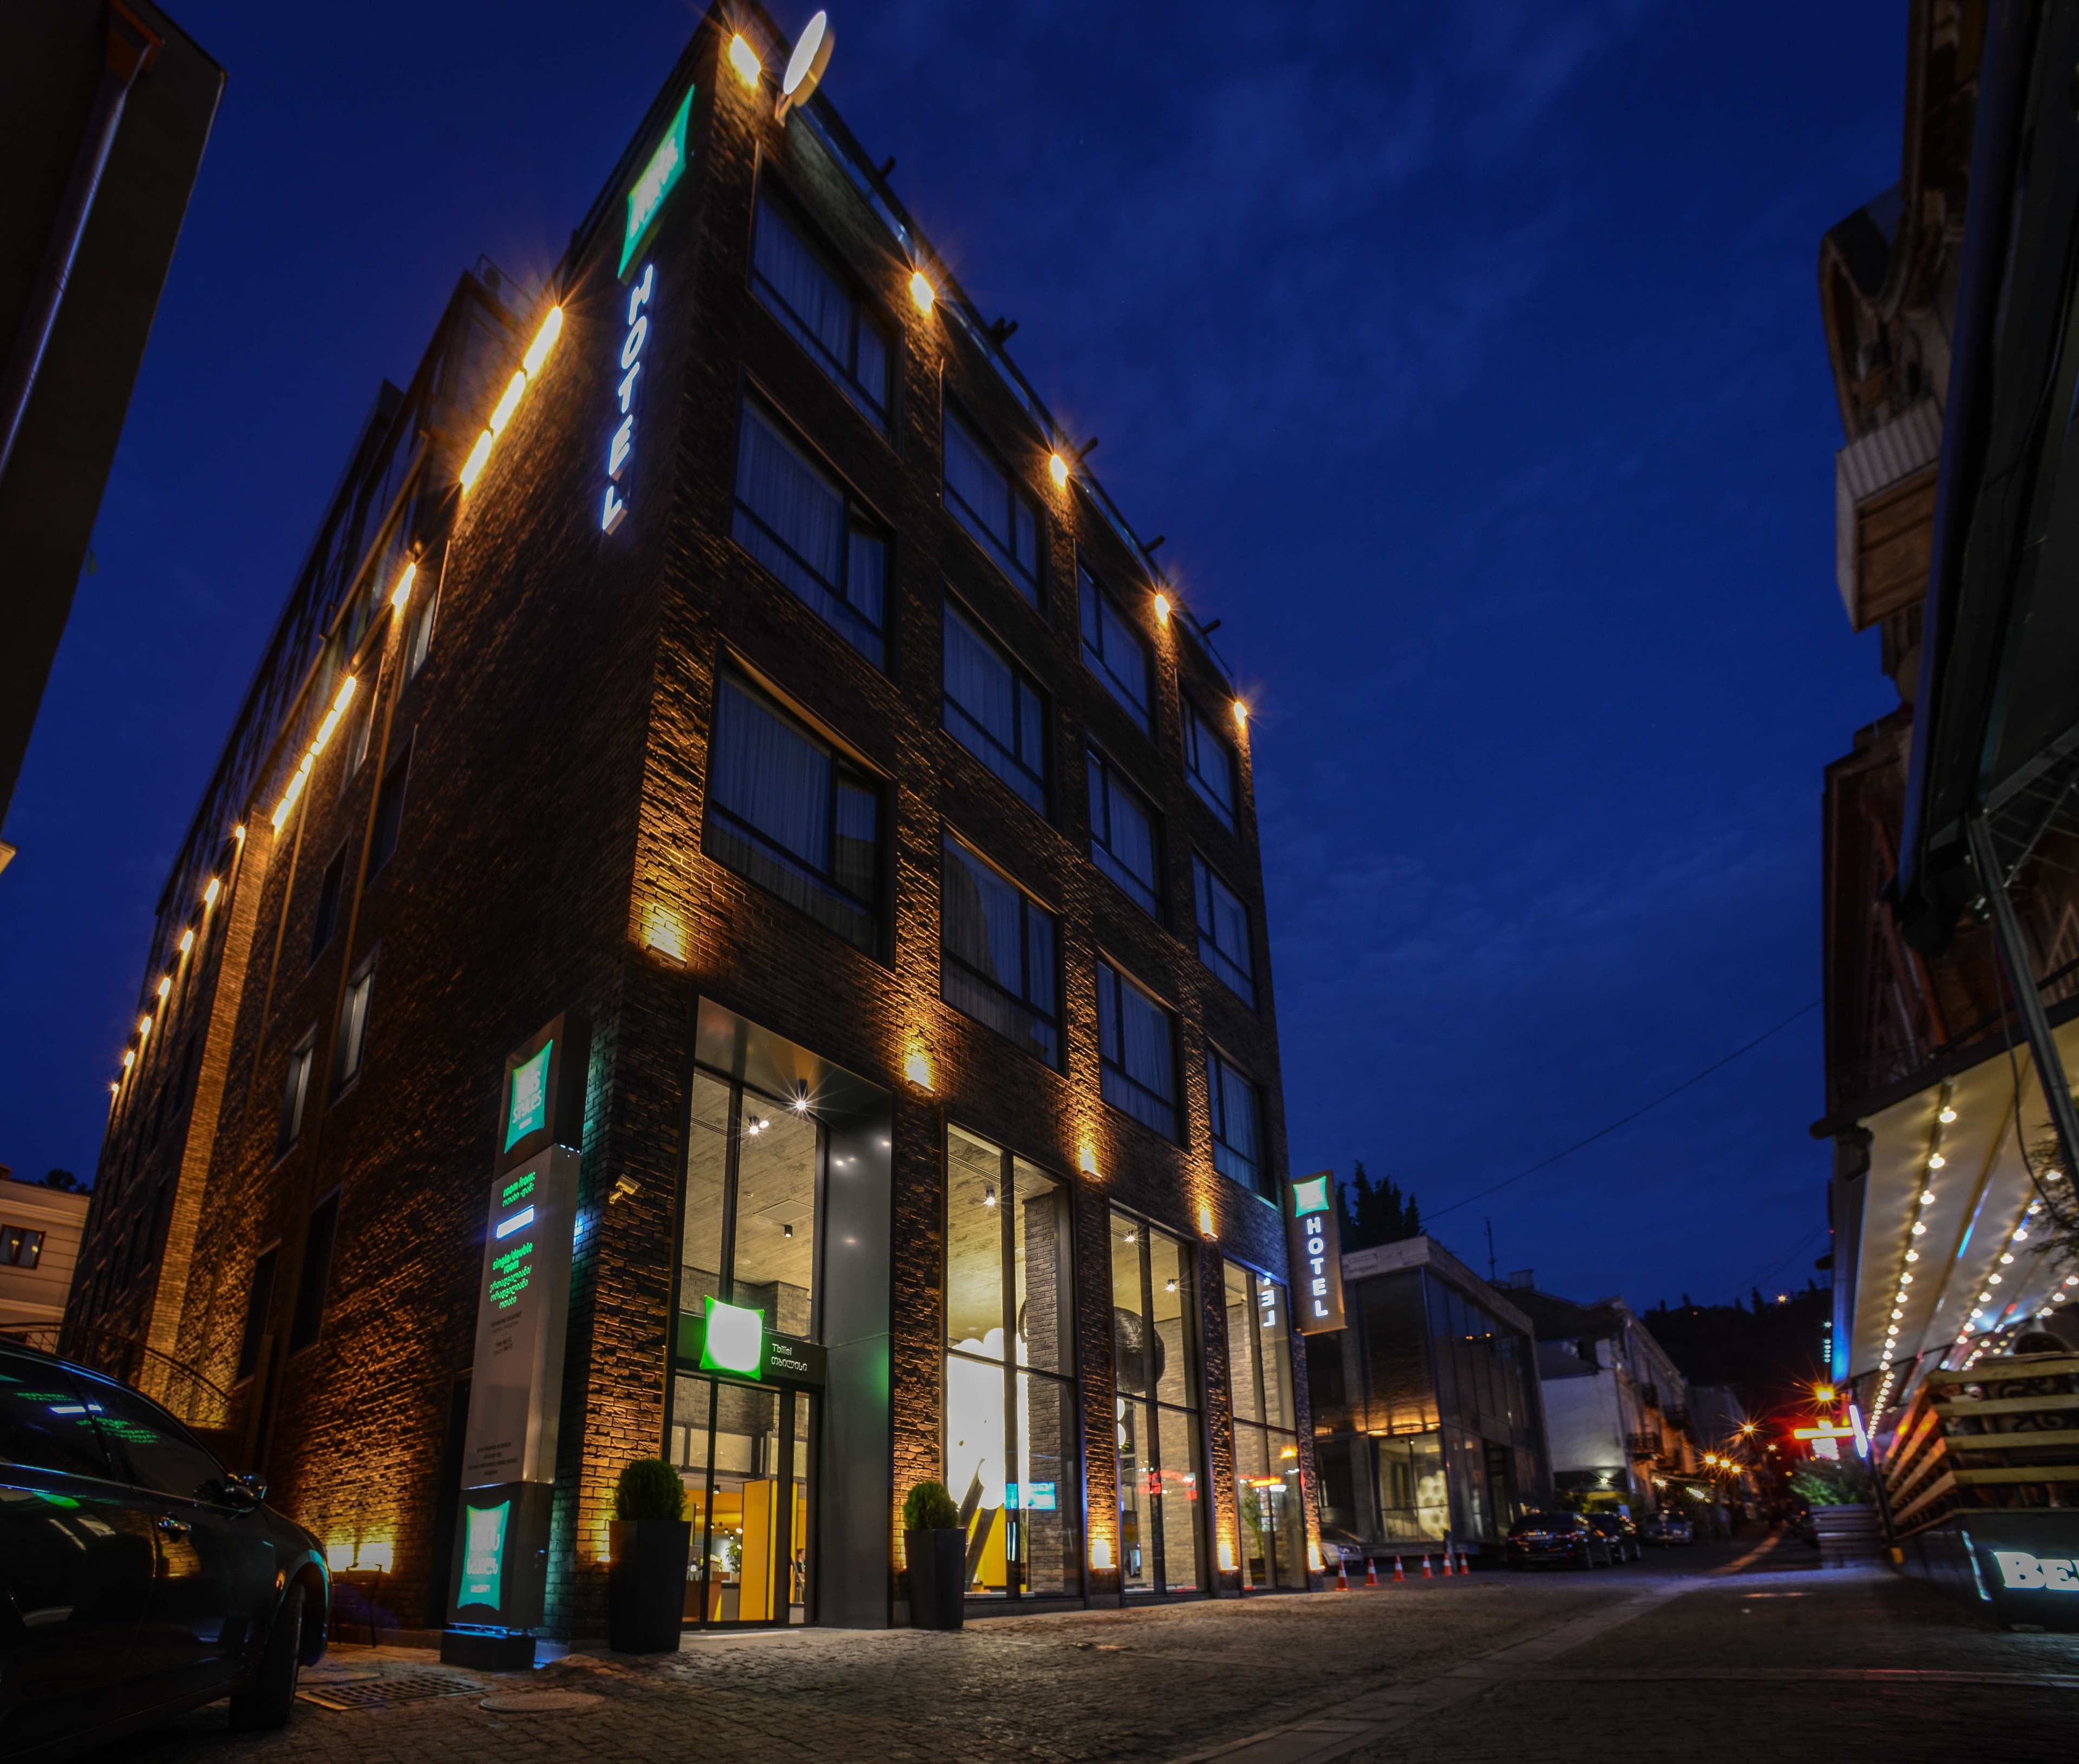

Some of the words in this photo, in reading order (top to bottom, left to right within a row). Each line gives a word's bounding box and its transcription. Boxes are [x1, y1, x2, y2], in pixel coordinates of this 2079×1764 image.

[602, 264, 653, 529] HOTEL
[504, 1182, 518, 1197] room
[520, 1172, 535, 1186] from:
[493, 1242, 532, 1270] single/double
[504, 1260, 519, 1274] room
[1306, 1217, 1328, 1316] HOTEL
[772, 1343, 792, 1356] Tbilisi
[772, 1356, 807, 1371] თბილისი
[1993, 1552, 2079, 1591] BE
